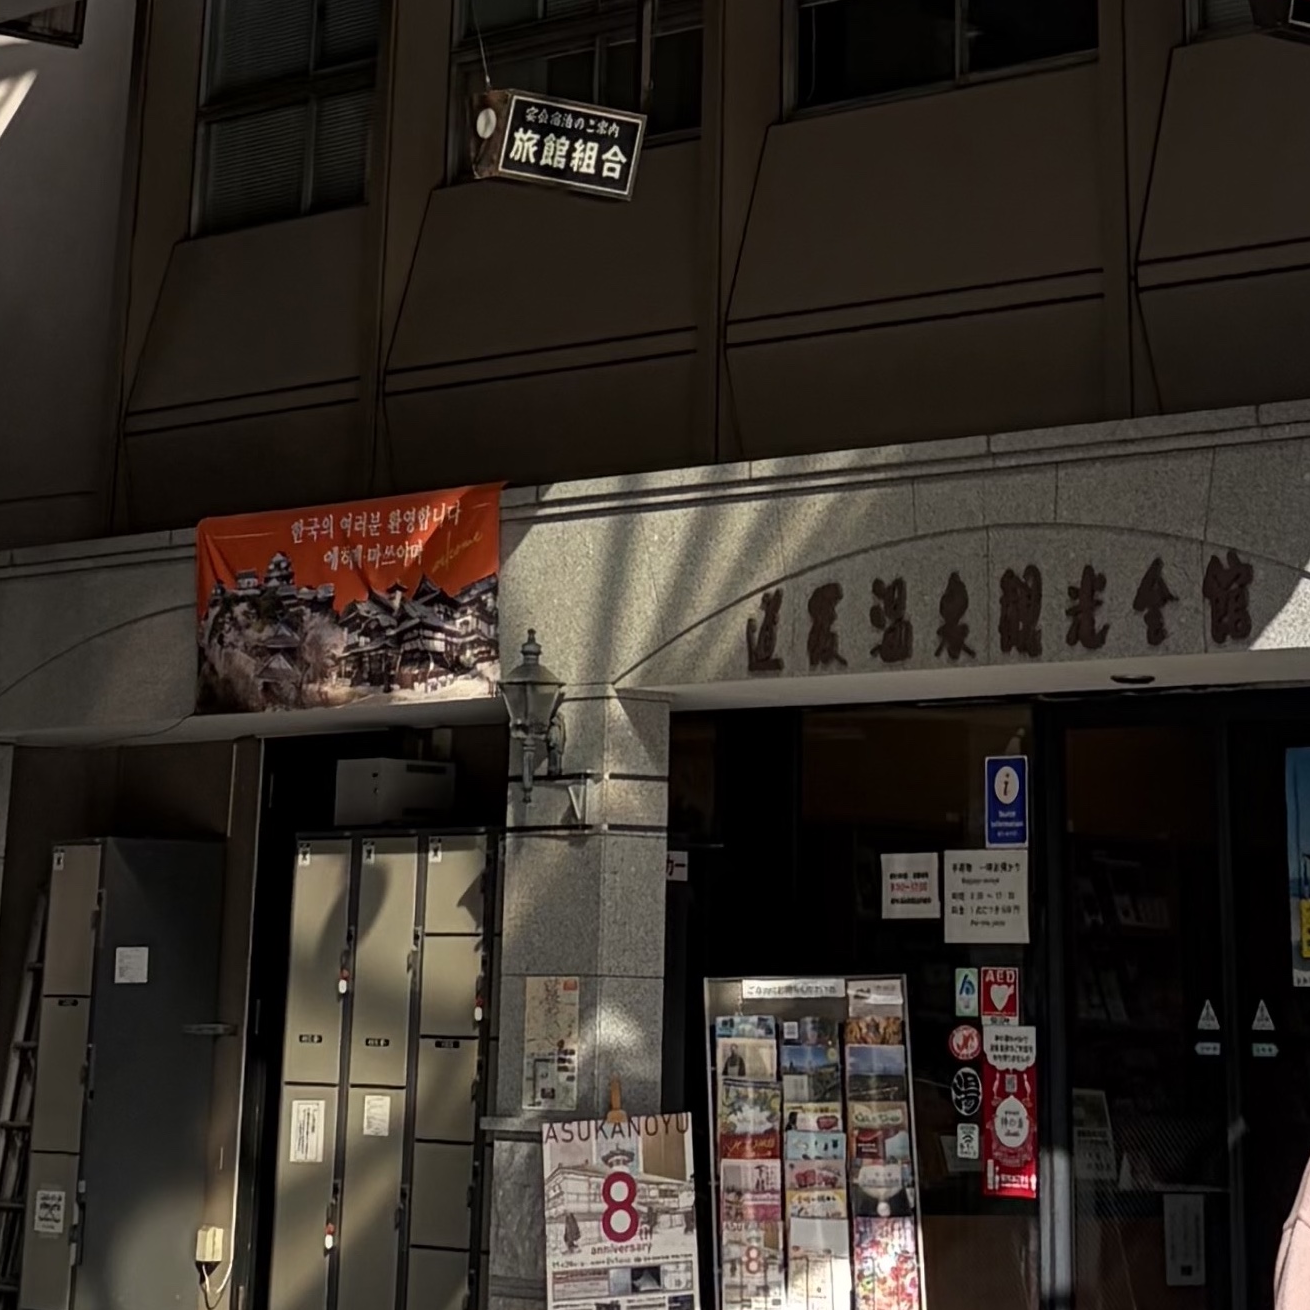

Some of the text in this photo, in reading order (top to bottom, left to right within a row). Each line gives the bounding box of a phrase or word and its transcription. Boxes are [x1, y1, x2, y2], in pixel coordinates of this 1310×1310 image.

[509, 127, 628, 180] 旅館組合
[291, 500, 461, 544] 한국의 여러분 환영합니다
[985, 970, 1016, 982] AED
[545, 1113, 689, 1144] ASUKANOYU
[591, 1241, 653, 1256] anniversary
